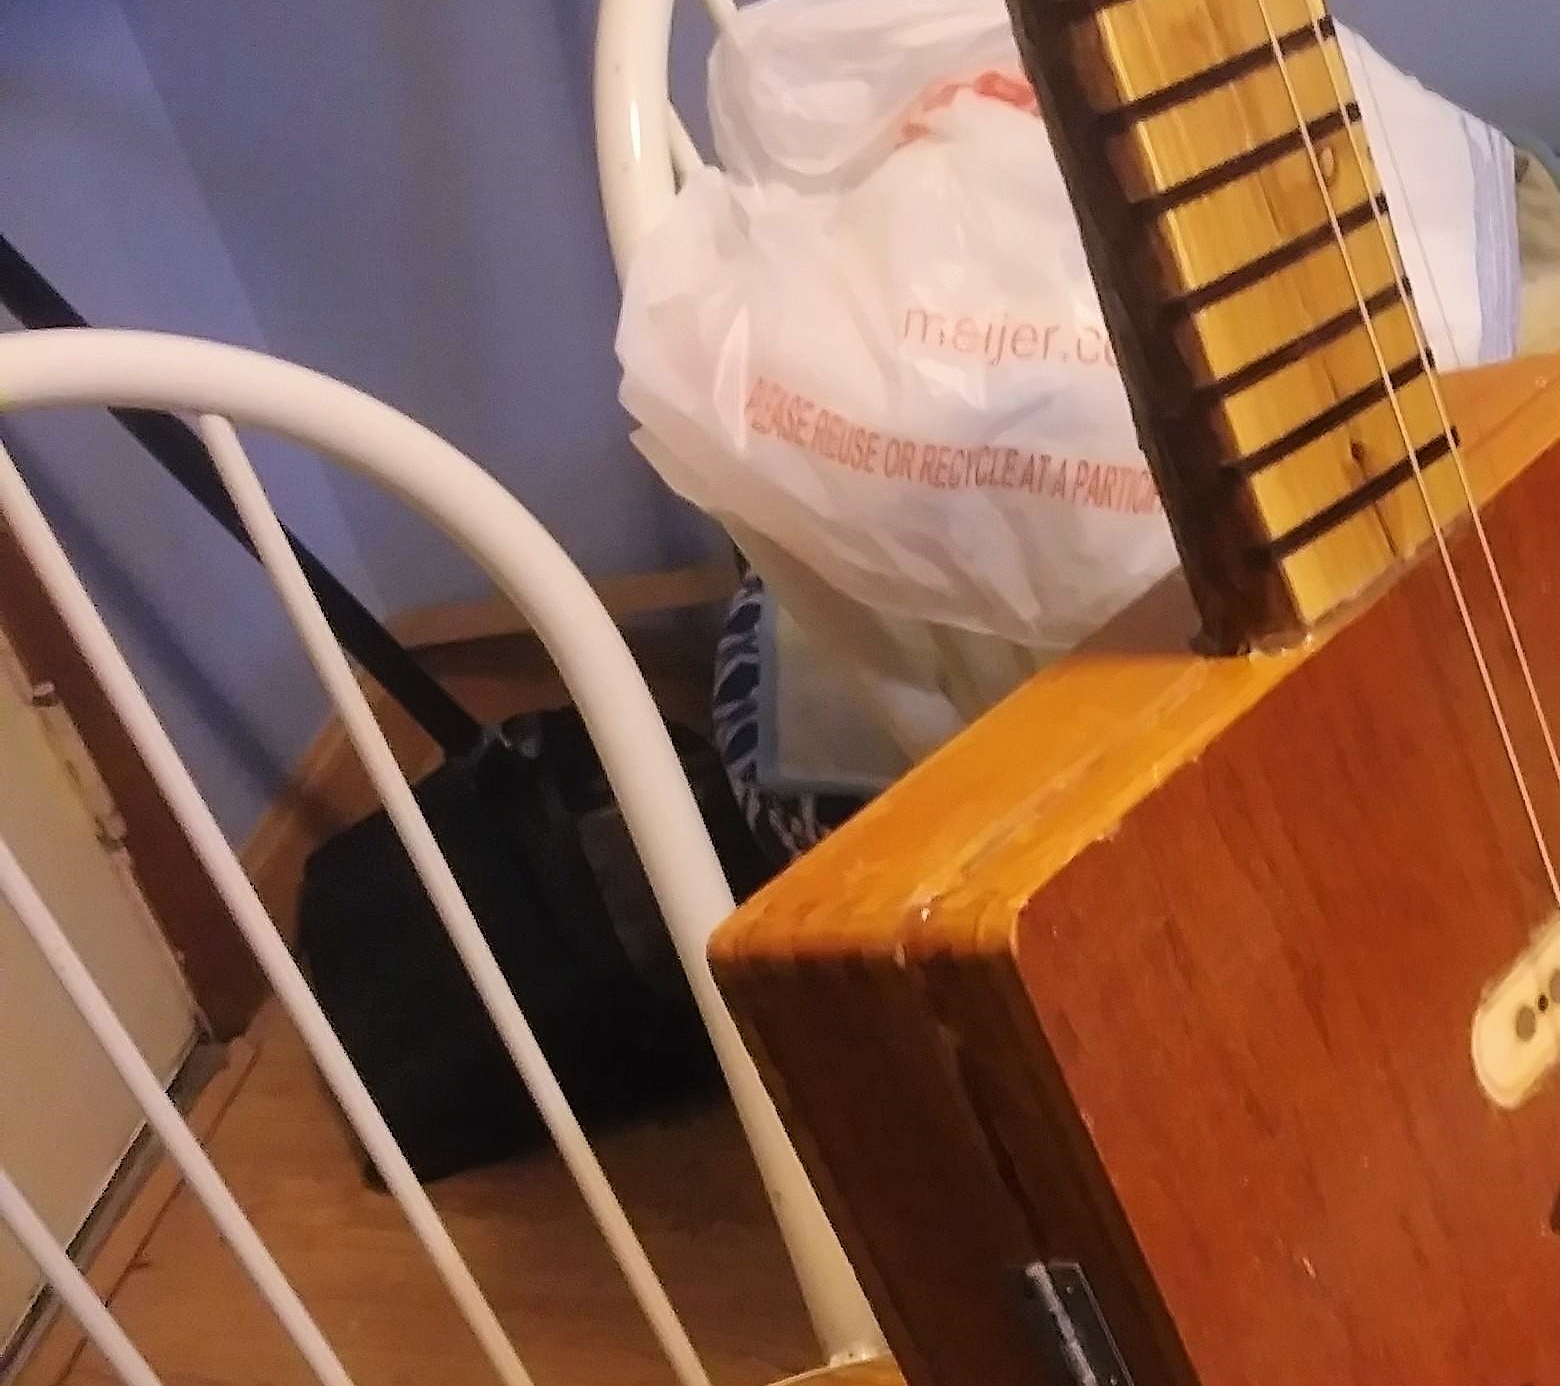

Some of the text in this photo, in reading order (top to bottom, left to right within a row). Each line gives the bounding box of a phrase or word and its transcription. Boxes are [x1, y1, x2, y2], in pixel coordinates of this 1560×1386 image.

[812, 409, 880, 474] REUSE
[884, 435, 916, 483] OR
[919, 443, 1020, 491] RECYCLE
[1019, 453, 1053, 495] AT
[1050, 458, 1067, 501] A
